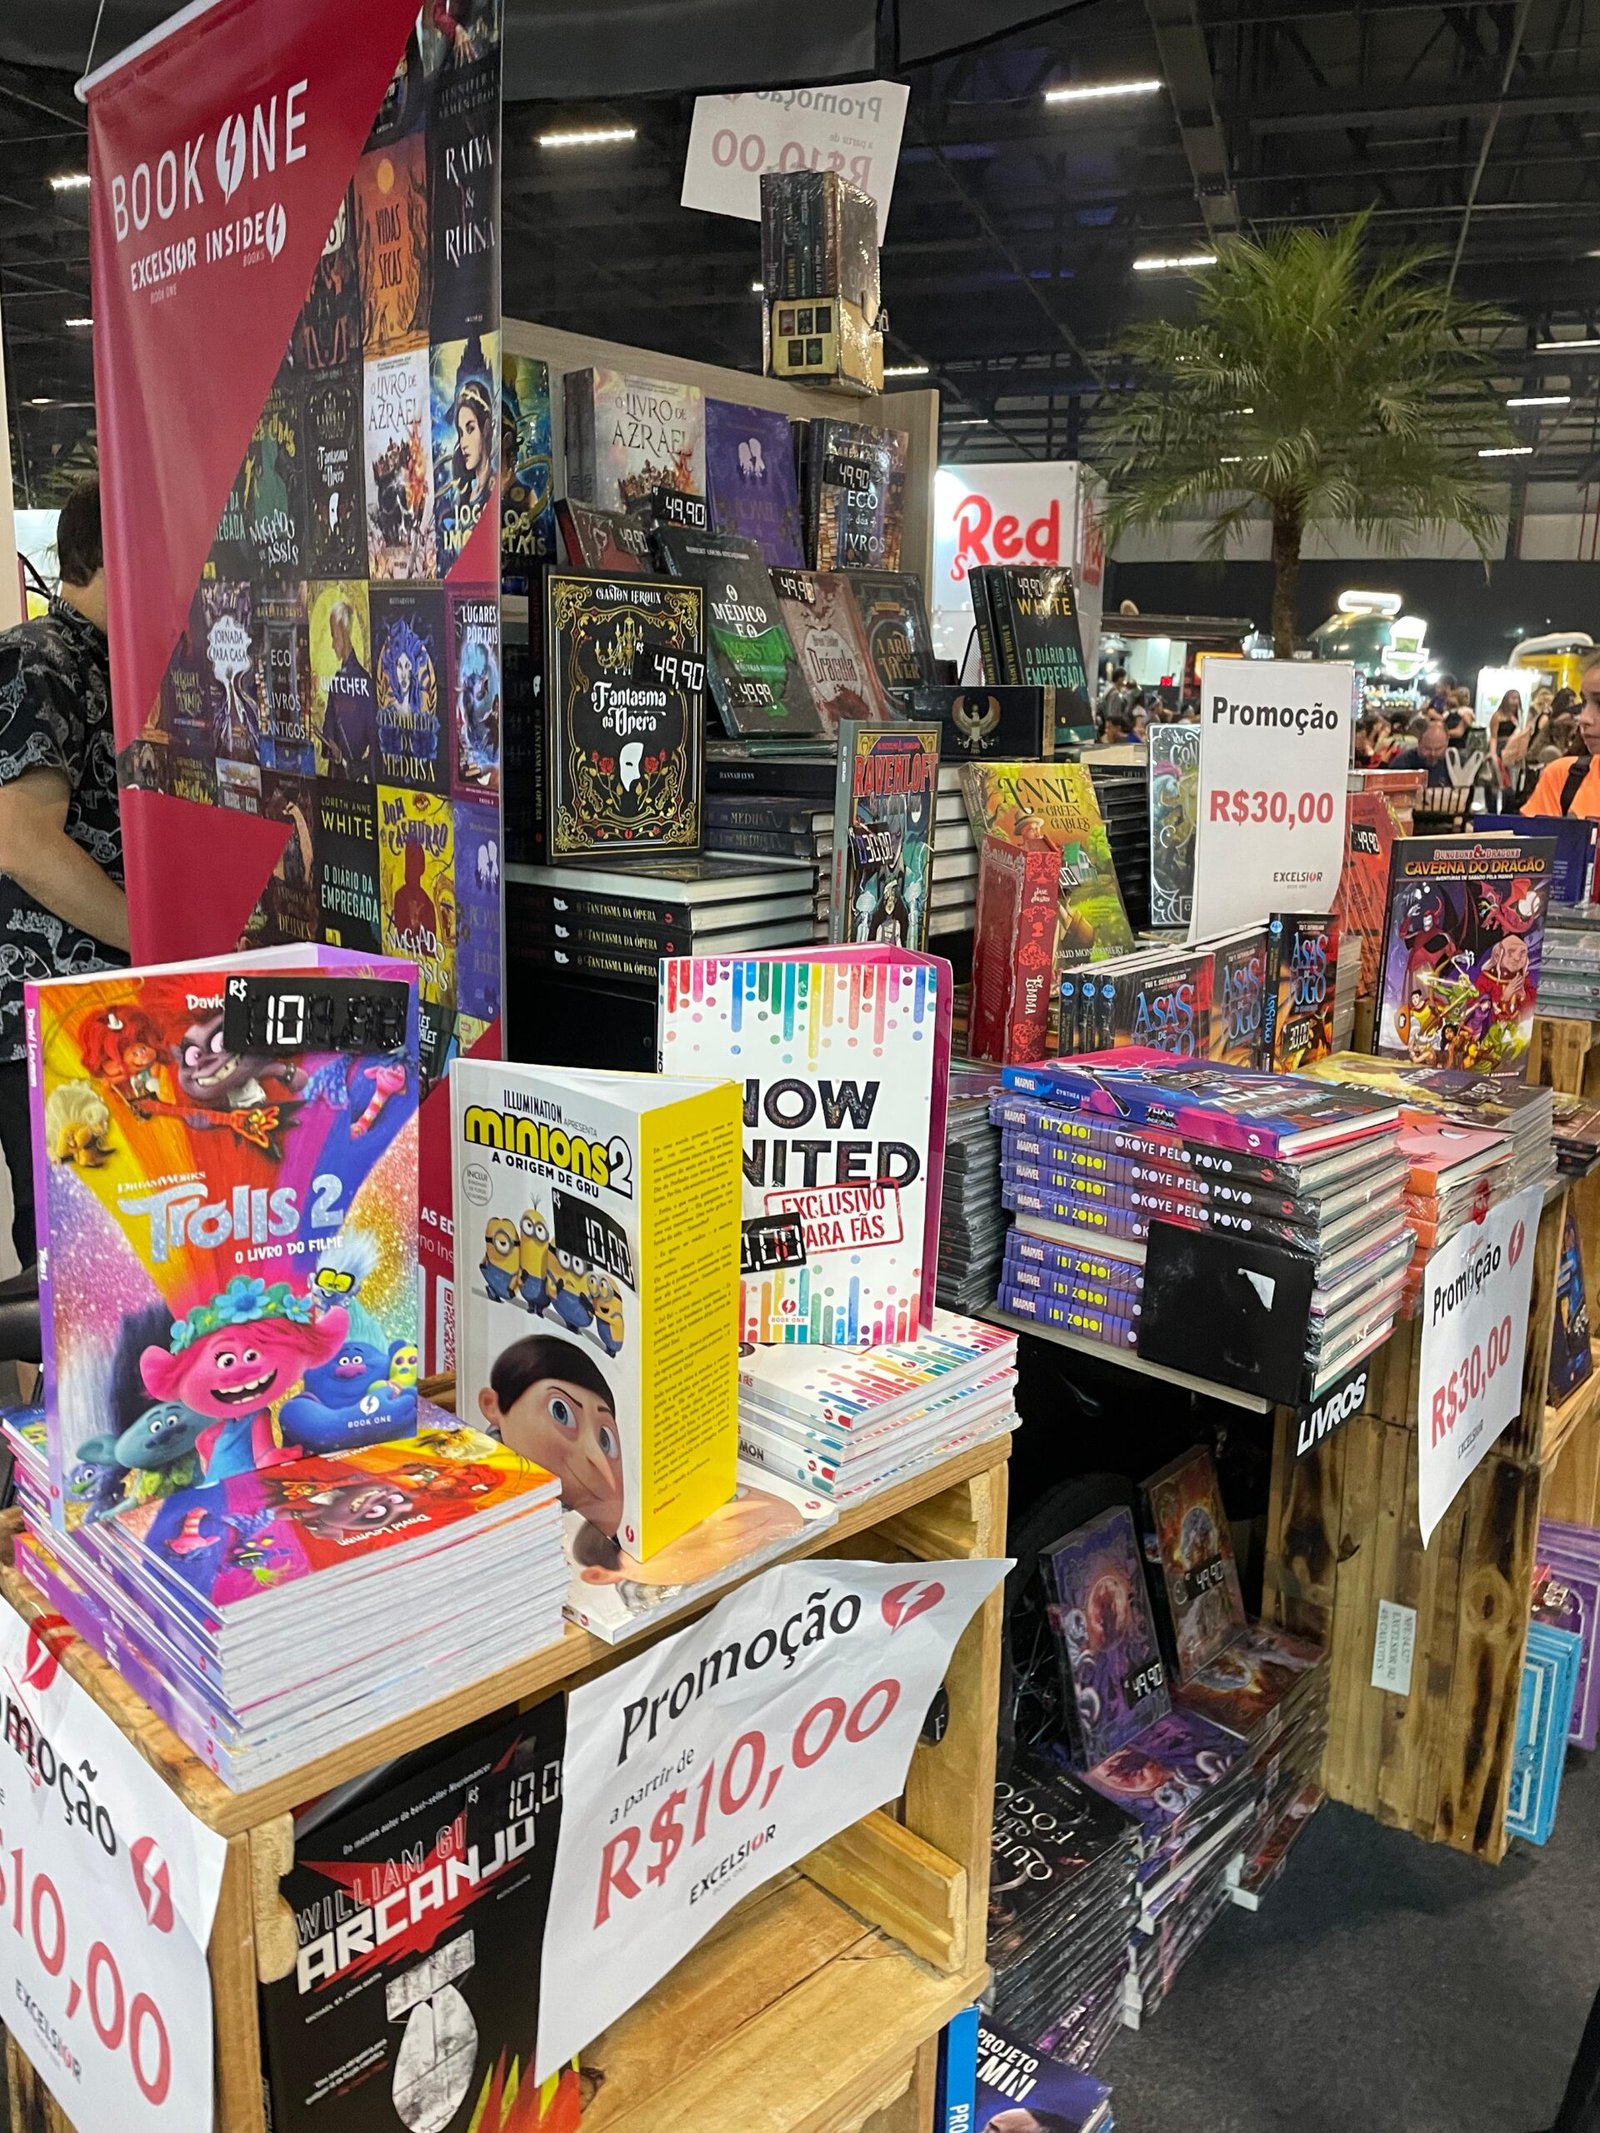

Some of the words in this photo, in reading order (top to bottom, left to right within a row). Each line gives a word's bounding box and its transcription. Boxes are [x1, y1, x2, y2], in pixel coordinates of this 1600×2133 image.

[112, 133, 204, 243] BOOK
[206, 211, 265, 264] INSIDE
[375, 204, 401, 247] VIDAS
[130, 237, 196, 292] EXCELSIOR
[378, 248, 402, 290] SECAS
[377, 372, 407, 402] LIVRO
[369, 399, 422, 433] AZRAEL
[625, 393, 673, 425] LIVRO
[675, 406, 688, 421] DE
[611, 420, 695, 458] AZRAEL
[840, 463, 870, 489] 49,90
[665, 496, 706, 525] 49,90
[847, 490, 879, 509] ECO
[953, 494, 1060, 566] Red
[596, 584, 628, 602] GASTON
[726, 584, 738, 603] O
[780, 577, 815, 603] 49,90
[1017, 577, 1043, 598] 49,90
[462, 605, 498, 624] LUGARES
[711, 598, 768, 624] MÉDICO
[1016, 598, 1073, 616] WHITE
[466, 627, 498, 644] PORTAIS
[270, 650, 293, 667] ECO
[1026, 648, 1033, 665] O
[1036, 643, 1064, 665] DIÁRIO
[1066, 647, 1079, 664] DA
[653, 653, 706, 692] 49,90
[1025, 666, 1087, 688] EMPREGADA
[267, 692, 302, 712] LIVROS
[592, 681, 667, 713] Fantasma
[608, 705, 657, 737] Ópera
[1211, 695, 1340, 736] Promoção
[266, 724, 307, 740] ANTIGOS
[383, 753, 436, 782] MEDUSA
[852, 752, 939, 798] RAVENLOFT
[999, 777, 1079, 819] ANNE
[1045, 804, 1082, 818] GREEN
[1210, 789, 1334, 831] R$30,00
[320, 809, 374, 841] WHITE
[332, 864, 360, 890] DIÁRIO
[361, 875, 374, 894] DA
[1273, 870, 1324, 884] EXCELSIOR
[1405, 861, 1466, 876] CAVERNA
[1469, 860, 1489, 875] DO
[1491, 857, 1546, 874] DRAGÃO
[321, 885, 380, 925] EMPREGADA
[229, 979, 247, 1001] R$
[267, 995, 304, 1045] 10
[1136, 983, 1194, 1034] ASAS
[1014, 1076, 1037, 1091] MARVEL
[504, 1088, 563, 1125] ILLUMINATION
[563, 1118, 598, 1137] APRESENTA
[743, 1078, 881, 1130] NOW
[1004, 1109, 1026, 1125] MARVEL
[1039, 1116, 1053, 1130] IBI
[1056, 1120, 1092, 1140] ZOBOI
[1016, 1139, 1040, 1155] MARVEL
[1052, 1148, 1068, 1162] IBI
[1071, 1152, 1107, 1171] ZOBOI
[1115, 1134, 1156, 1155] OKOYE
[1159, 1146, 1191, 1164] PELO
[1195, 1154, 1233, 1173] POVO
[117, 1170, 207, 1195] DREAMWORKS
[466, 1168, 488, 1184] INCLUI
[491, 1152, 502, 1166] A
[506, 1154, 555, 1180] ORIGEM
[558, 1172, 574, 1188] DE
[576, 1177, 600, 1199] GRU
[1131, 1166, 1174, 1188] OKOYE
[1177, 1175, 1210, 1195] PELO
[1213, 1186, 1252, 1205] POVO
[310, 1173, 345, 1229] 2
[421, 1207, 437, 1225] AS
[781, 1186, 886, 1220] EXCLUSIVO
[1017, 1193, 1041, 1211] MARVEL
[1053, 1203, 1068, 1218] IBI
[1071, 1207, 1108, 1228] ZOBOI
[1131, 1192, 1174, 1213] OKOYE
[1177, 1203, 1209, 1223] PELO
[1213, 1212, 1252, 1232] POVO
[851, 1213, 885, 1242] FÃS
[234, 1250, 244, 1264] O
[247, 1243, 283, 1263] LIVRO
[286, 1240, 306, 1256] DO
[309, 1235, 345, 1253] FILME
[585, 1215, 637, 1292] 10,00
[1432, 1243, 1503, 1329] Promoção
[1012, 1295, 1037, 1314] MARVEL
[1048, 1307, 1064, 1322] IBI
[1067, 1311, 1103, 1333] ZOBOI
[1431, 1315, 1513, 1450] R$30,00
[347, 1417, 369, 1429] BOOK
[372, 1414, 392, 1426] ONE
[1297, 1372, 1368, 1456] LIVROS
[1457, 1418, 1485, 1461] EXCELSIOR
[394, 1513, 432, 1534] David
[618, 1588, 862, 1768] Promoção
[2, 1694, 119, 1857] moção
[609, 1807, 621, 1825] a
[623, 1766, 673, 1822] partir
[676, 1746, 695, 1774] de
[593, 1677, 902, 1932] R$10,00
[689, 1823, 778, 1906] EXCELSIOR
[295, 1840, 425, 1945] WILLIAM
[296, 1816, 537, 1995] ARCANJO
[0, 1828, 172, 2107] 10,00
[14, 1977, 84, 2085] EXCELSIOR
[977, 2027, 1040, 2073] PROJETO
